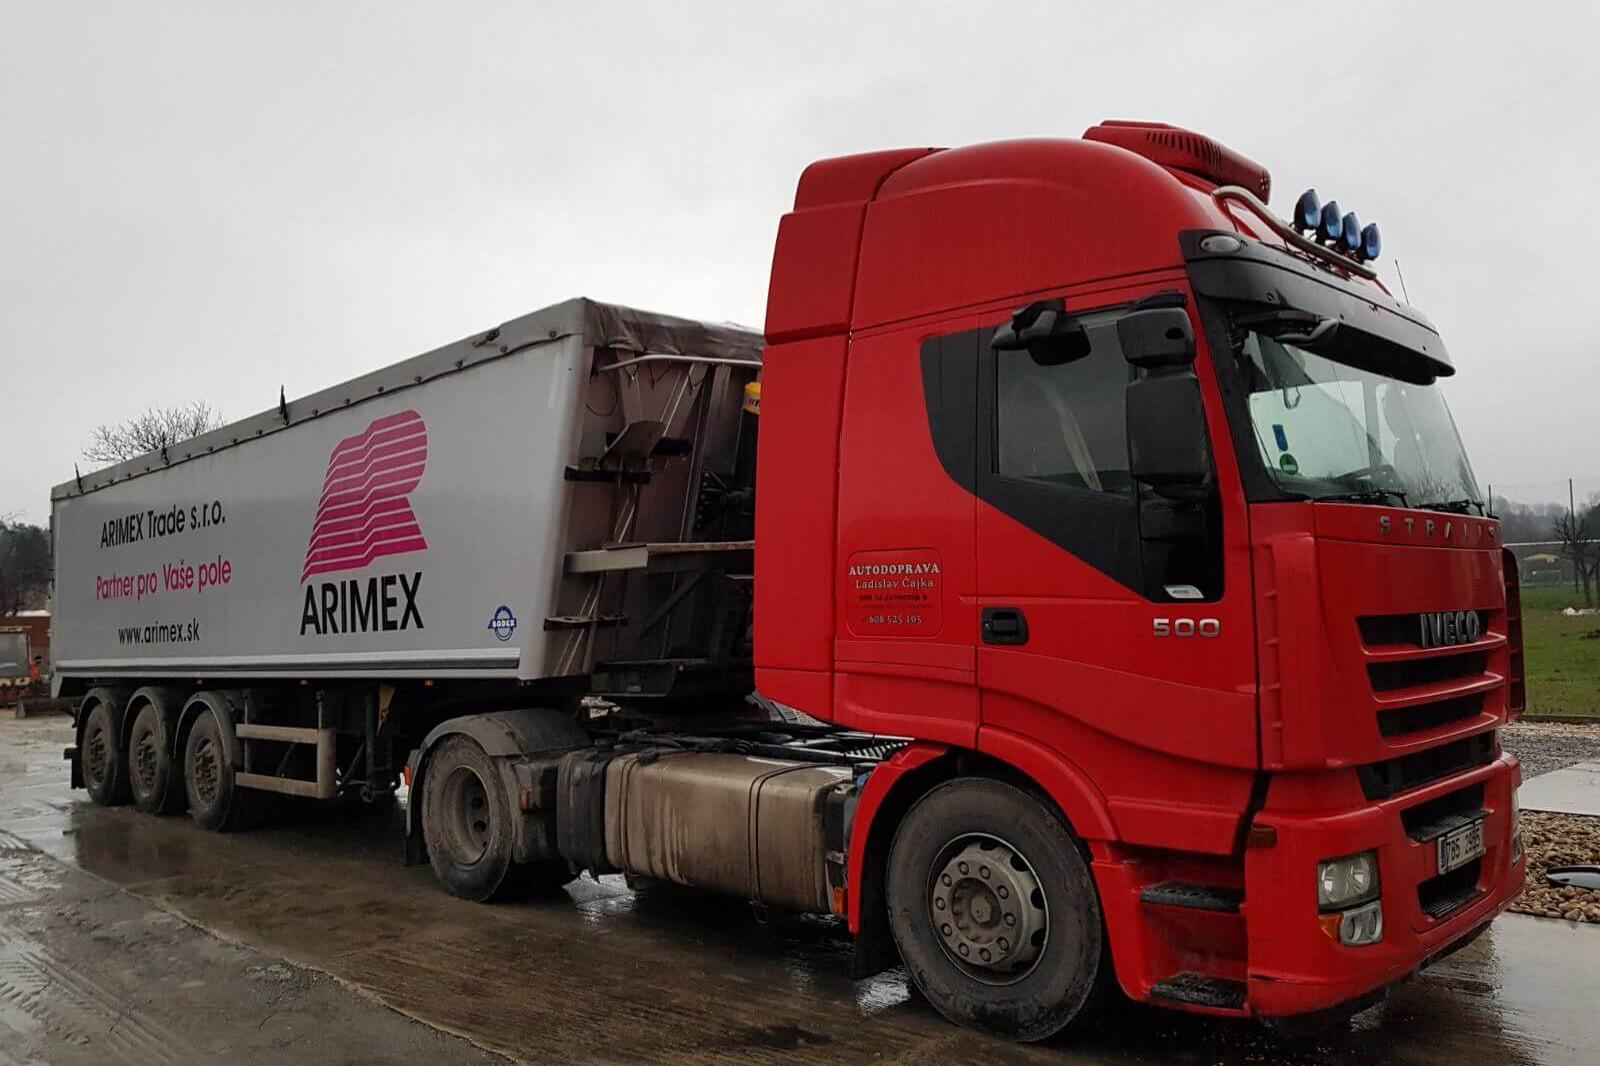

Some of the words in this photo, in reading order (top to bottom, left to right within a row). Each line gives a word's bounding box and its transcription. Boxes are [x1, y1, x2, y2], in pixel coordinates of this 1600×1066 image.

[101, 511, 144, 549] ARIMEX
[147, 504, 186, 539] Trade
[190, 500, 226, 531] s.r.o.
[96, 574, 135, 601] Partner
[137, 571, 158, 601] pro
[162, 558, 194, 591] Vaše
[198, 554, 232, 594] pole
[849, 562, 940, 576] AUTODOPRAVA
[855, 579, 898, 589] Ladislav
[300, 571, 425, 636] ARIMEX
[118, 617, 201, 645] www.arimex.sk
[1153, 618, 1220, 637] 500
[1419, 610, 1480, 649] IVECO
